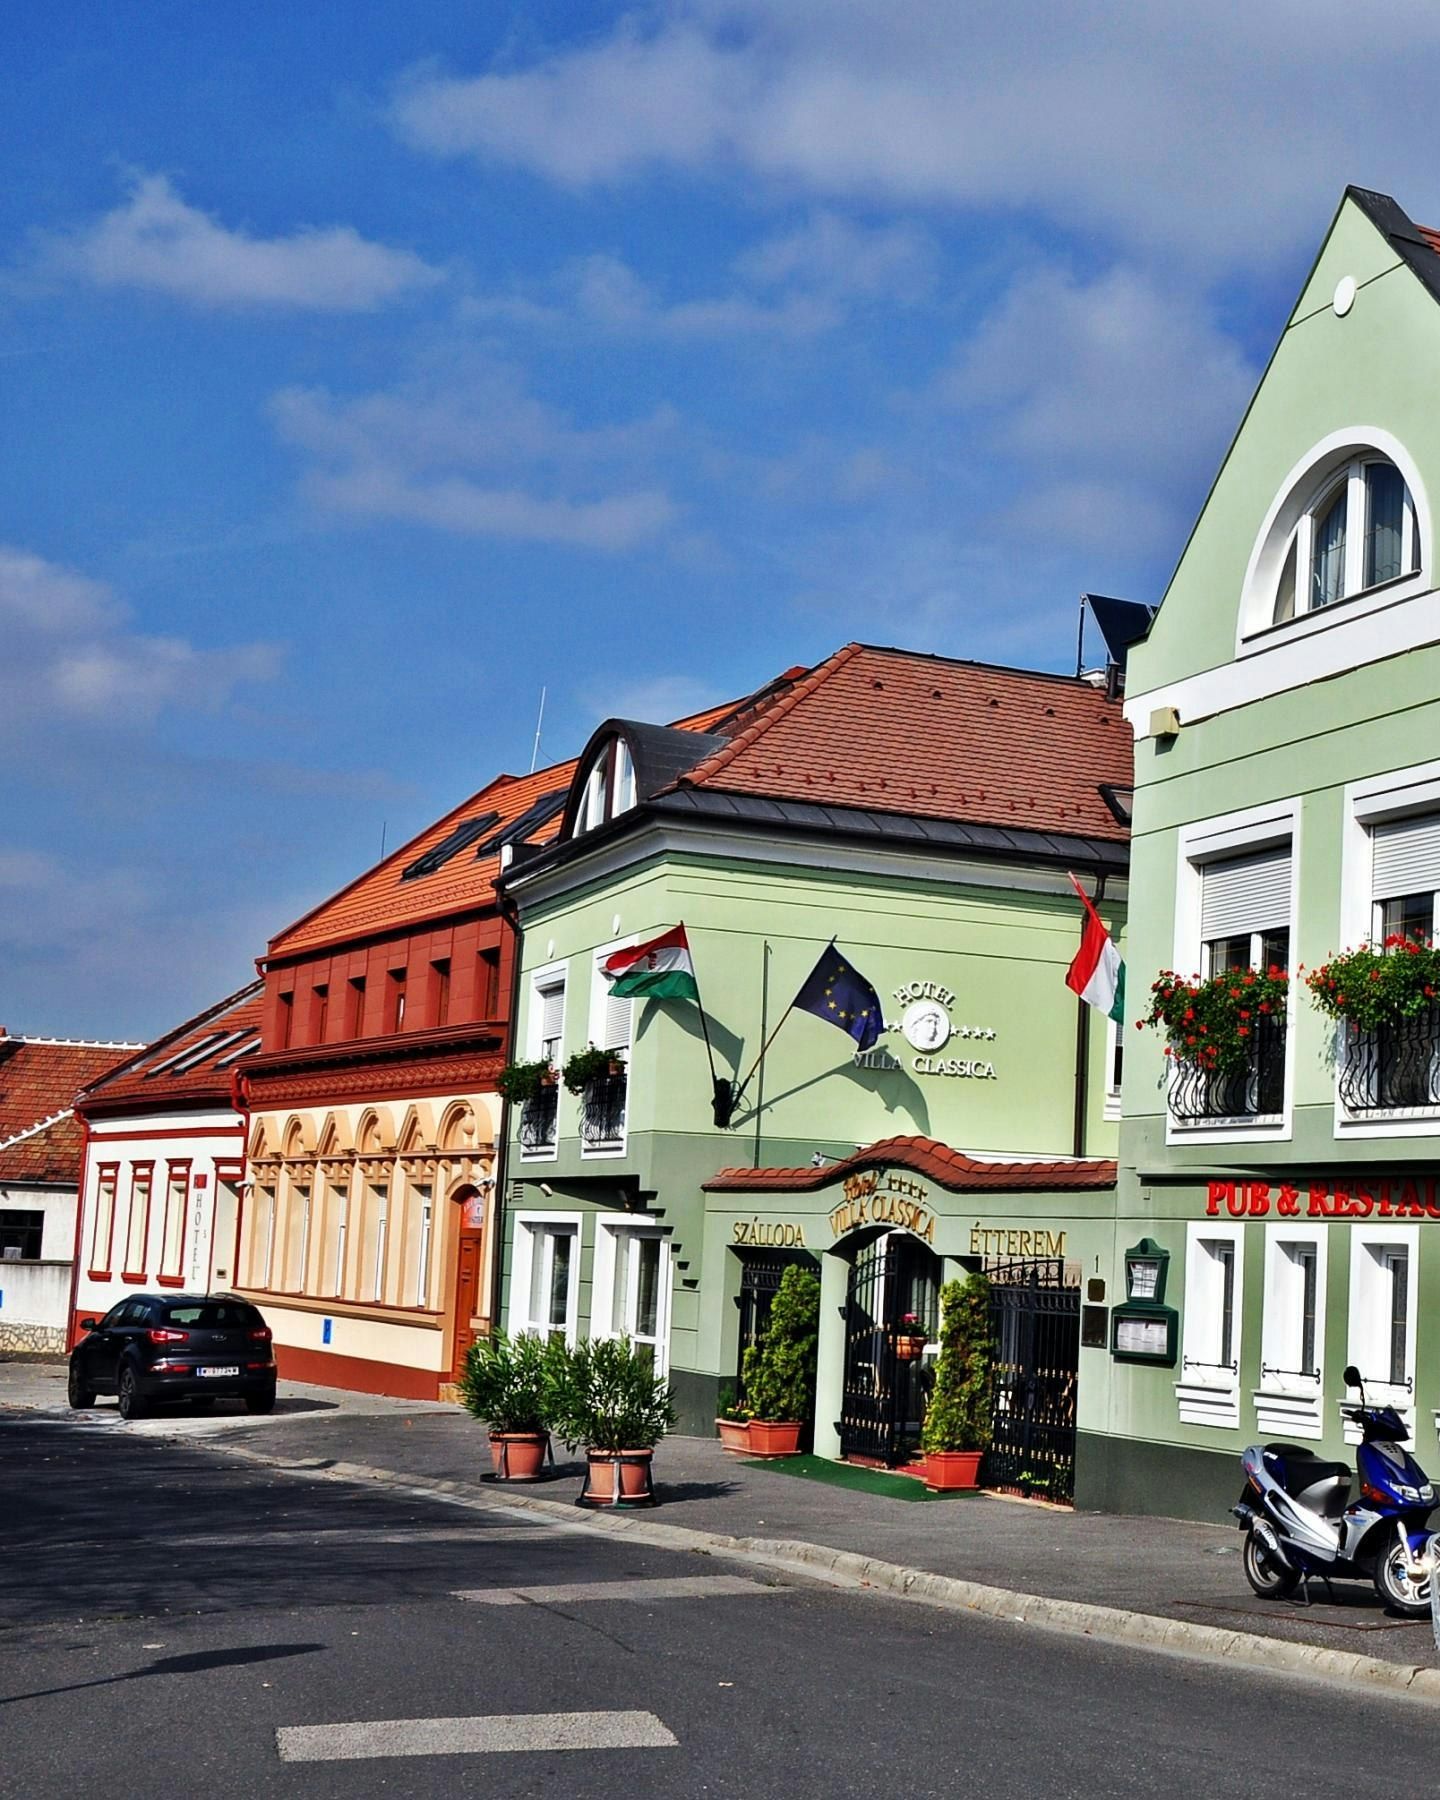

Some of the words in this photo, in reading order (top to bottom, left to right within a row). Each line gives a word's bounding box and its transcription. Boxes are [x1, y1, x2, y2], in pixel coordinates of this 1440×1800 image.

[893, 981, 957, 1012] HOTEL
[852, 1051, 904, 1070] VILLA
[912, 1056, 997, 1080] CLASSICA
[1206, 1180, 1270, 1217] PUB
[1277, 1184, 1301, 1217] &
[733, 1216, 806, 1247] SZÁLLODA
[829, 1200, 869, 1239] VILLA
[872, 1195, 936, 1245] CLASSICA
[970, 1221, 1067, 1258] ÉTTEREM
